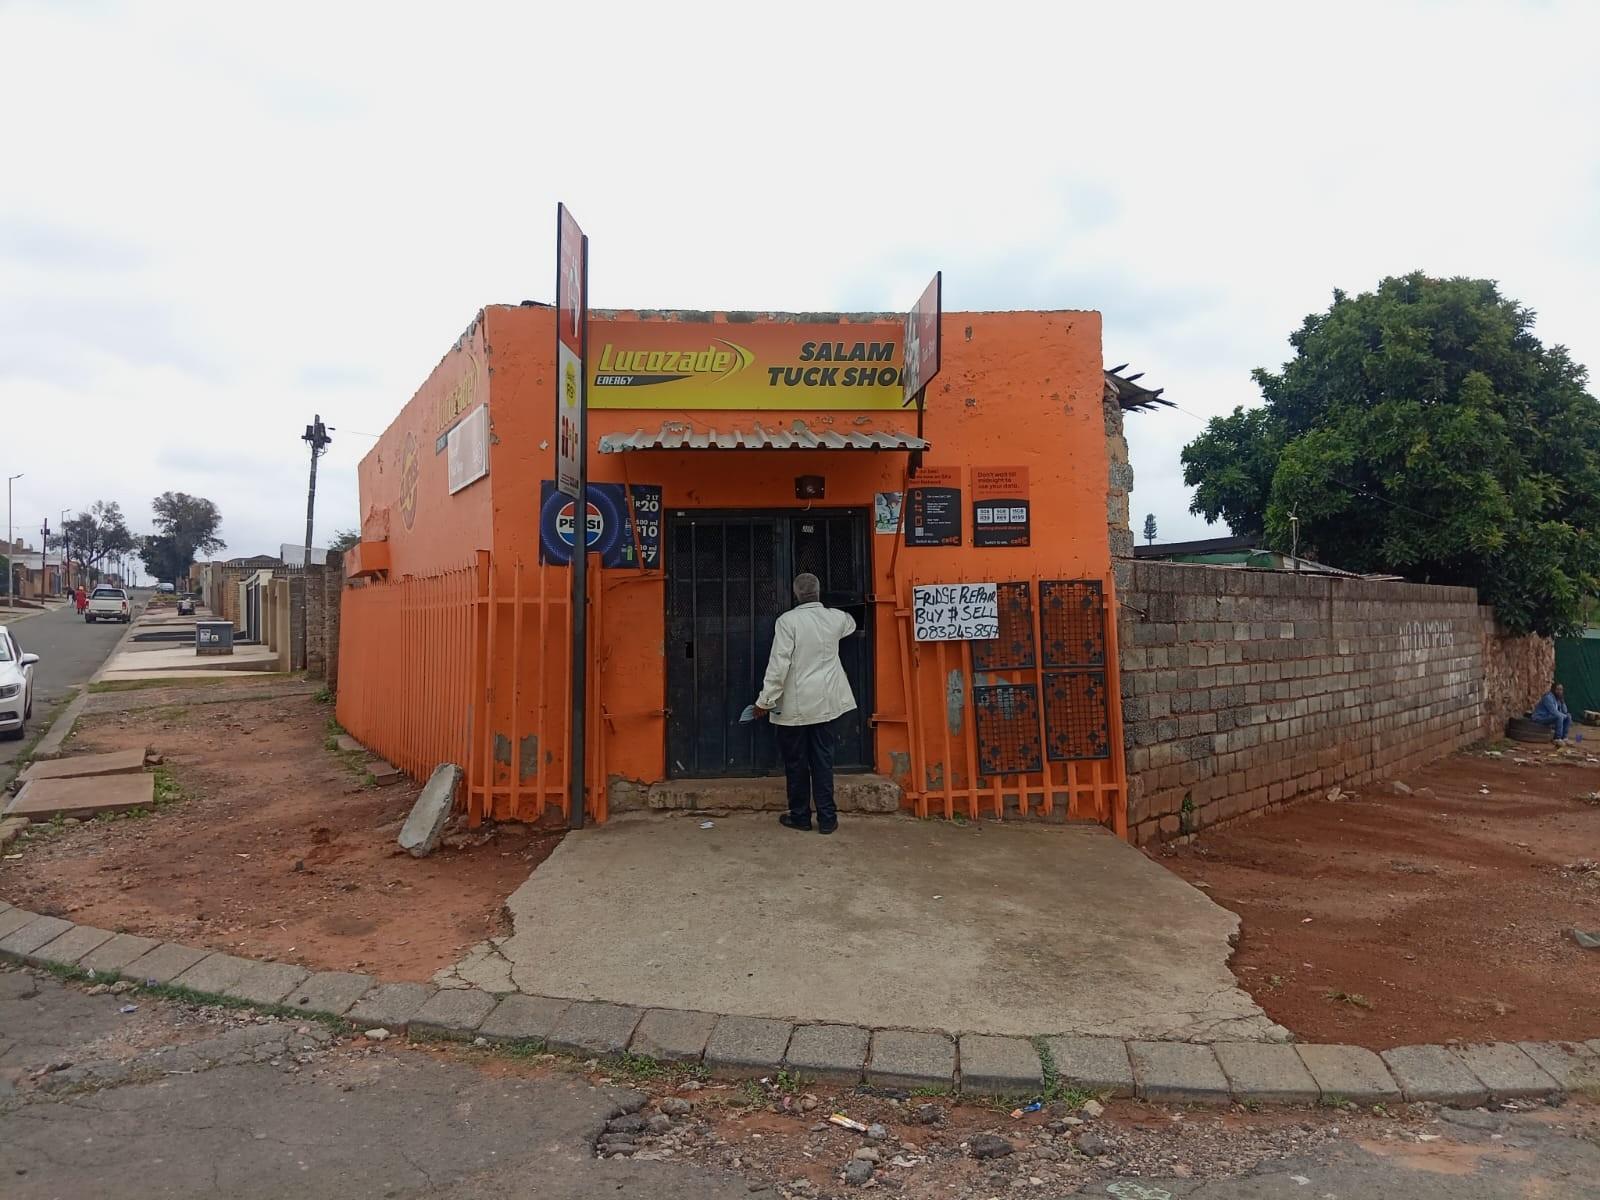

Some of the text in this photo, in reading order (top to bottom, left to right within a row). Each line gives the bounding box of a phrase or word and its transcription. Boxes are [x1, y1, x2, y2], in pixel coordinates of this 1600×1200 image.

[599, 344, 730, 372] Lucozade
[799, 342, 895, 361] SALAM
[596, 376, 634, 386] ENERGY
[768, 367, 839, 387] TUCK
[560, 518, 600, 530] PESI
[642, 551, 656, 562] R7
[914, 586, 996, 606] FRIDGE REPAIR
[915, 607, 944, 624] BUY
[961, 605, 998, 621] SELL
